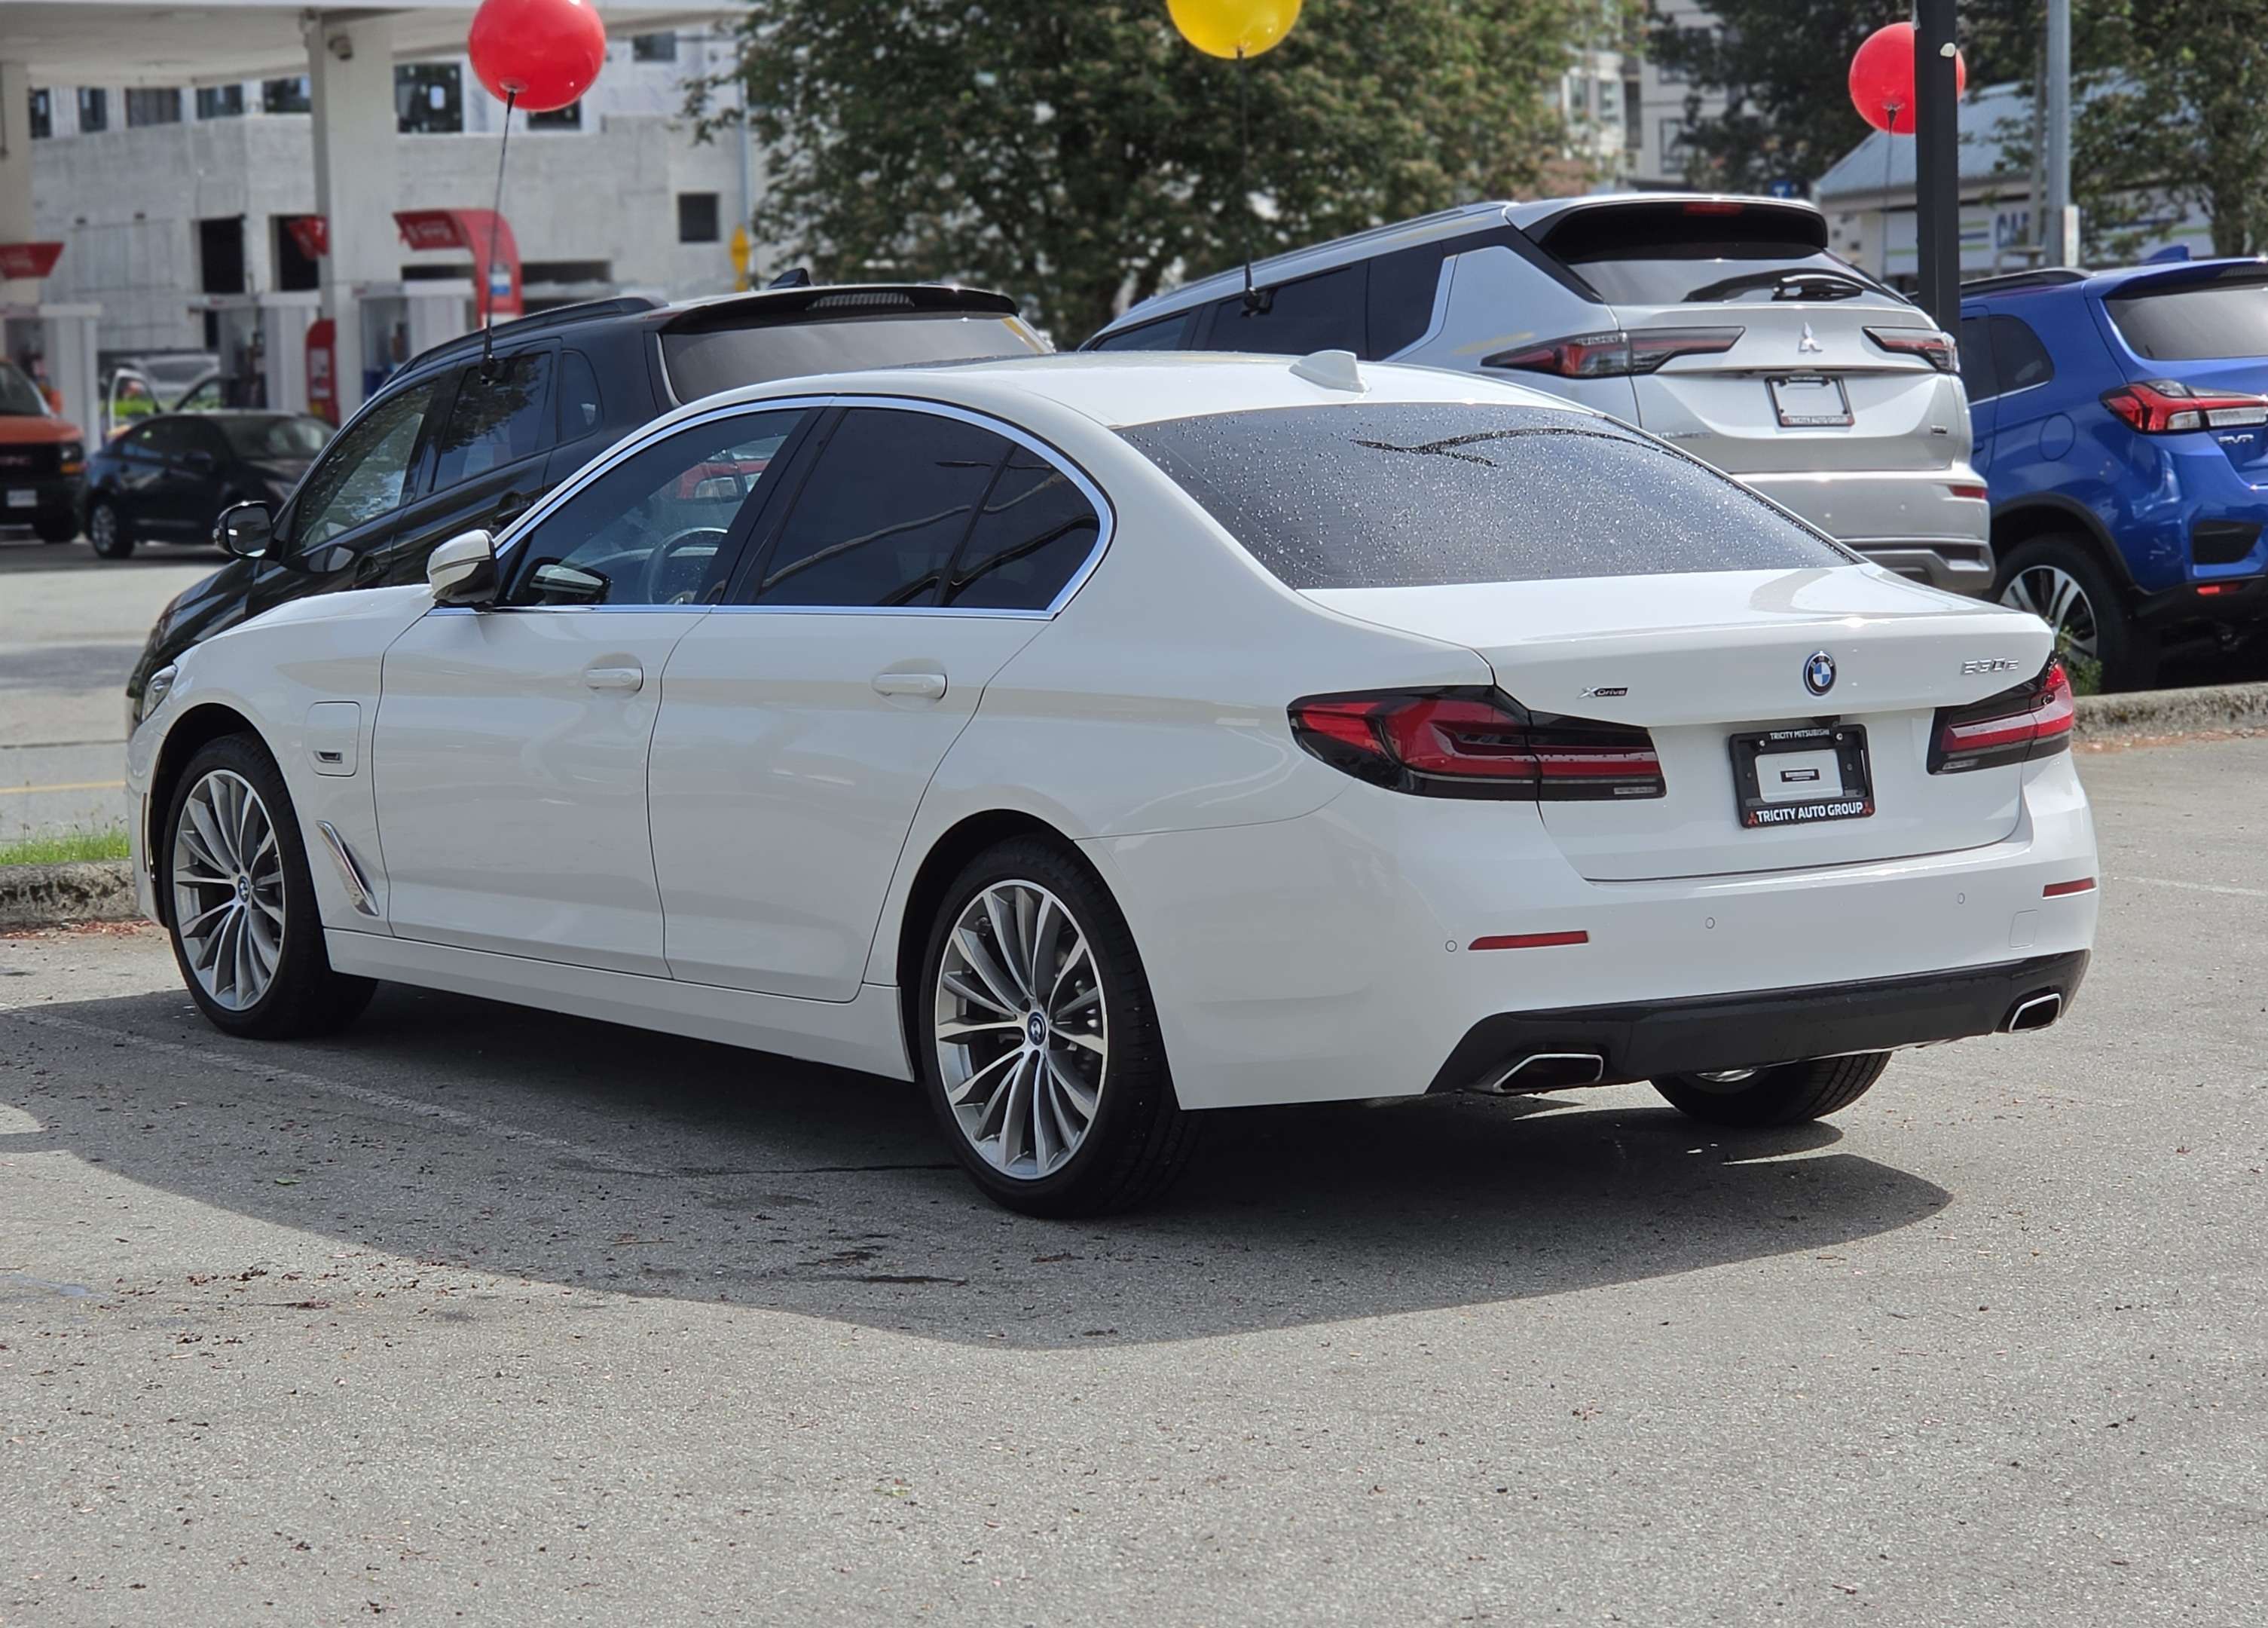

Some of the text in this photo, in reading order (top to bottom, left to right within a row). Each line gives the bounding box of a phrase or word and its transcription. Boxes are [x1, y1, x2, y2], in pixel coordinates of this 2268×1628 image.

[1770, 729, 1830, 740] TRICITY MITSUBISHI
[1756, 801, 1863, 822] TRICITY AUTO GROUP
